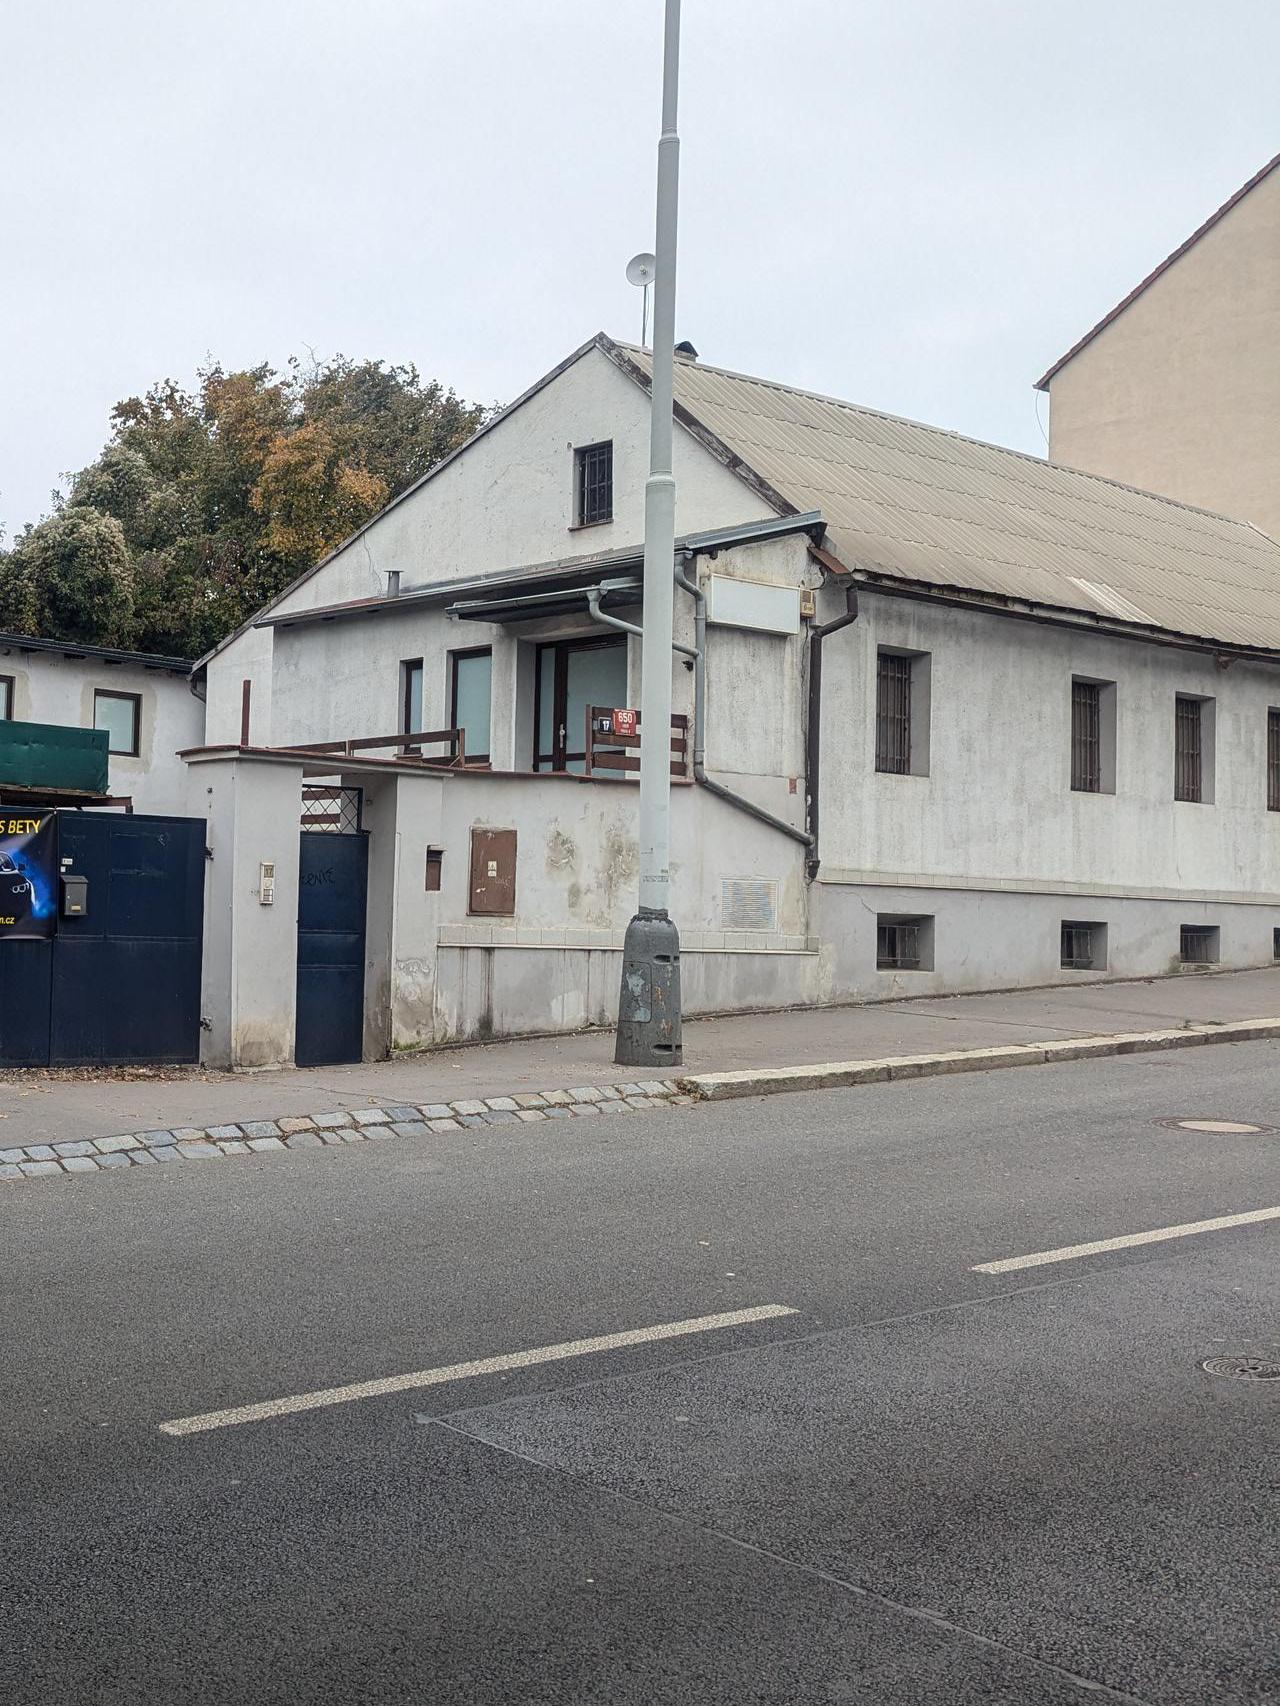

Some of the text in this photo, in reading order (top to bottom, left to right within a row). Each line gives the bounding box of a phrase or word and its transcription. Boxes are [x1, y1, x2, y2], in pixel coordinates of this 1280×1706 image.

[618, 712, 632, 723] 650
[602, 720, 610, 731] 17
[7, 819, 41, 834] BETY
